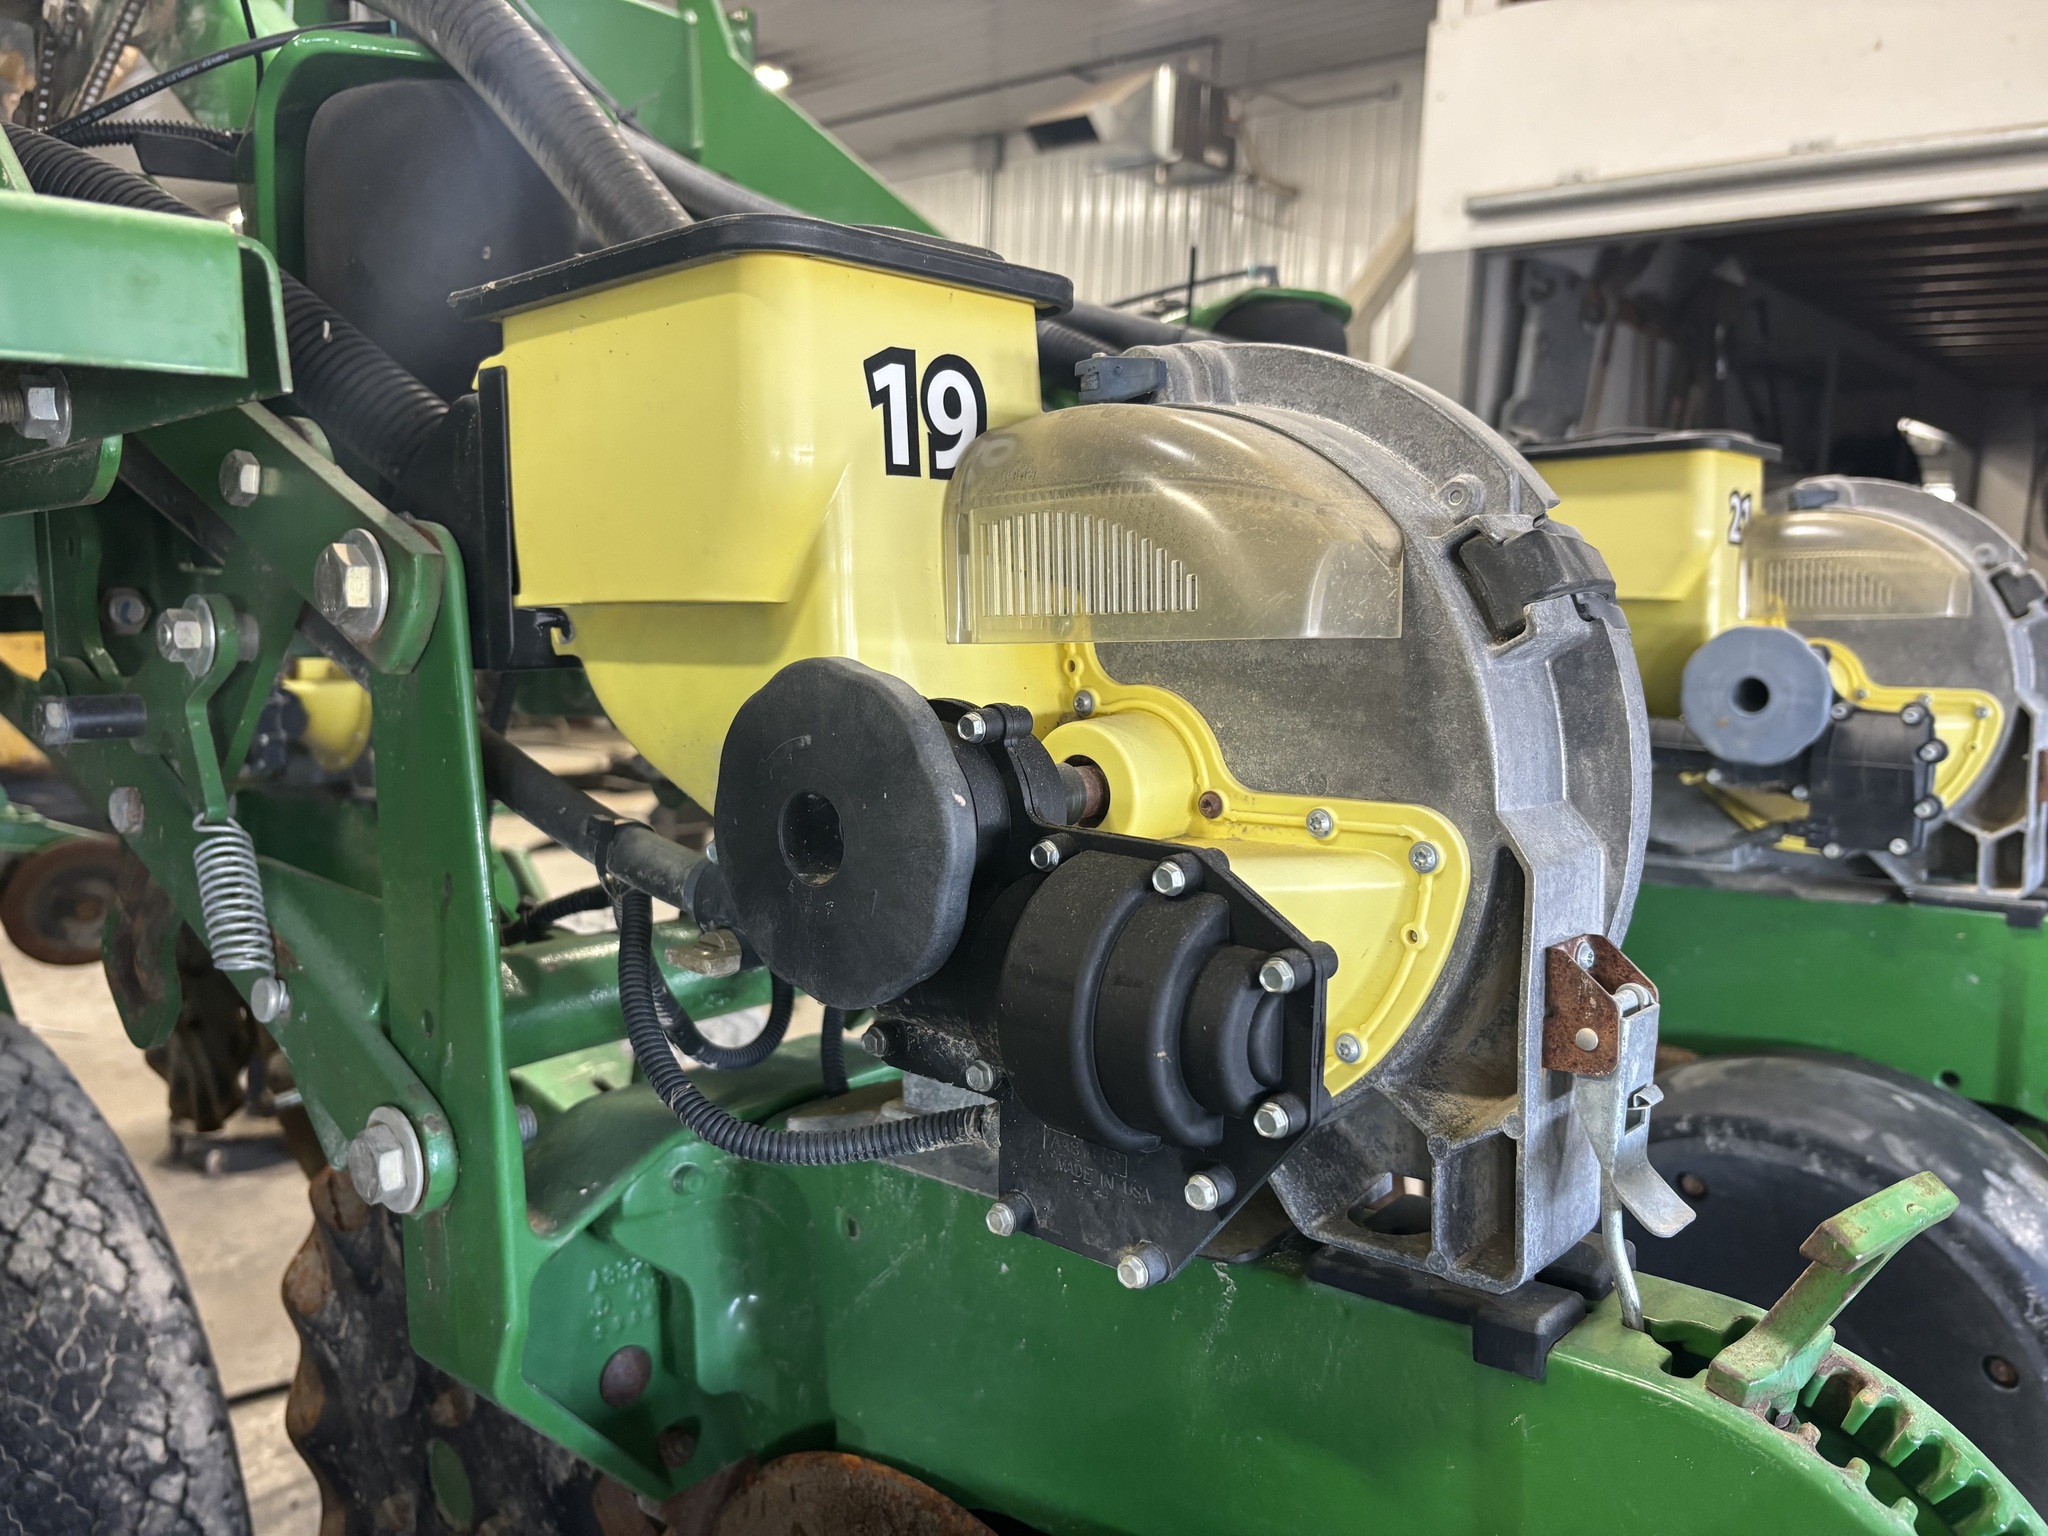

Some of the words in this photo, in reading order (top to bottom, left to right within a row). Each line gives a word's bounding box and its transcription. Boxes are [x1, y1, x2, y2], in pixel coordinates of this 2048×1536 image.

[863, 346, 988, 480] 19
[1727, 490, 1752, 545] 21
[1055, 1158, 1094, 1183] MADE
[1100, 1173, 1115, 1190] IN
[1122, 1180, 1152, 1203] USA
